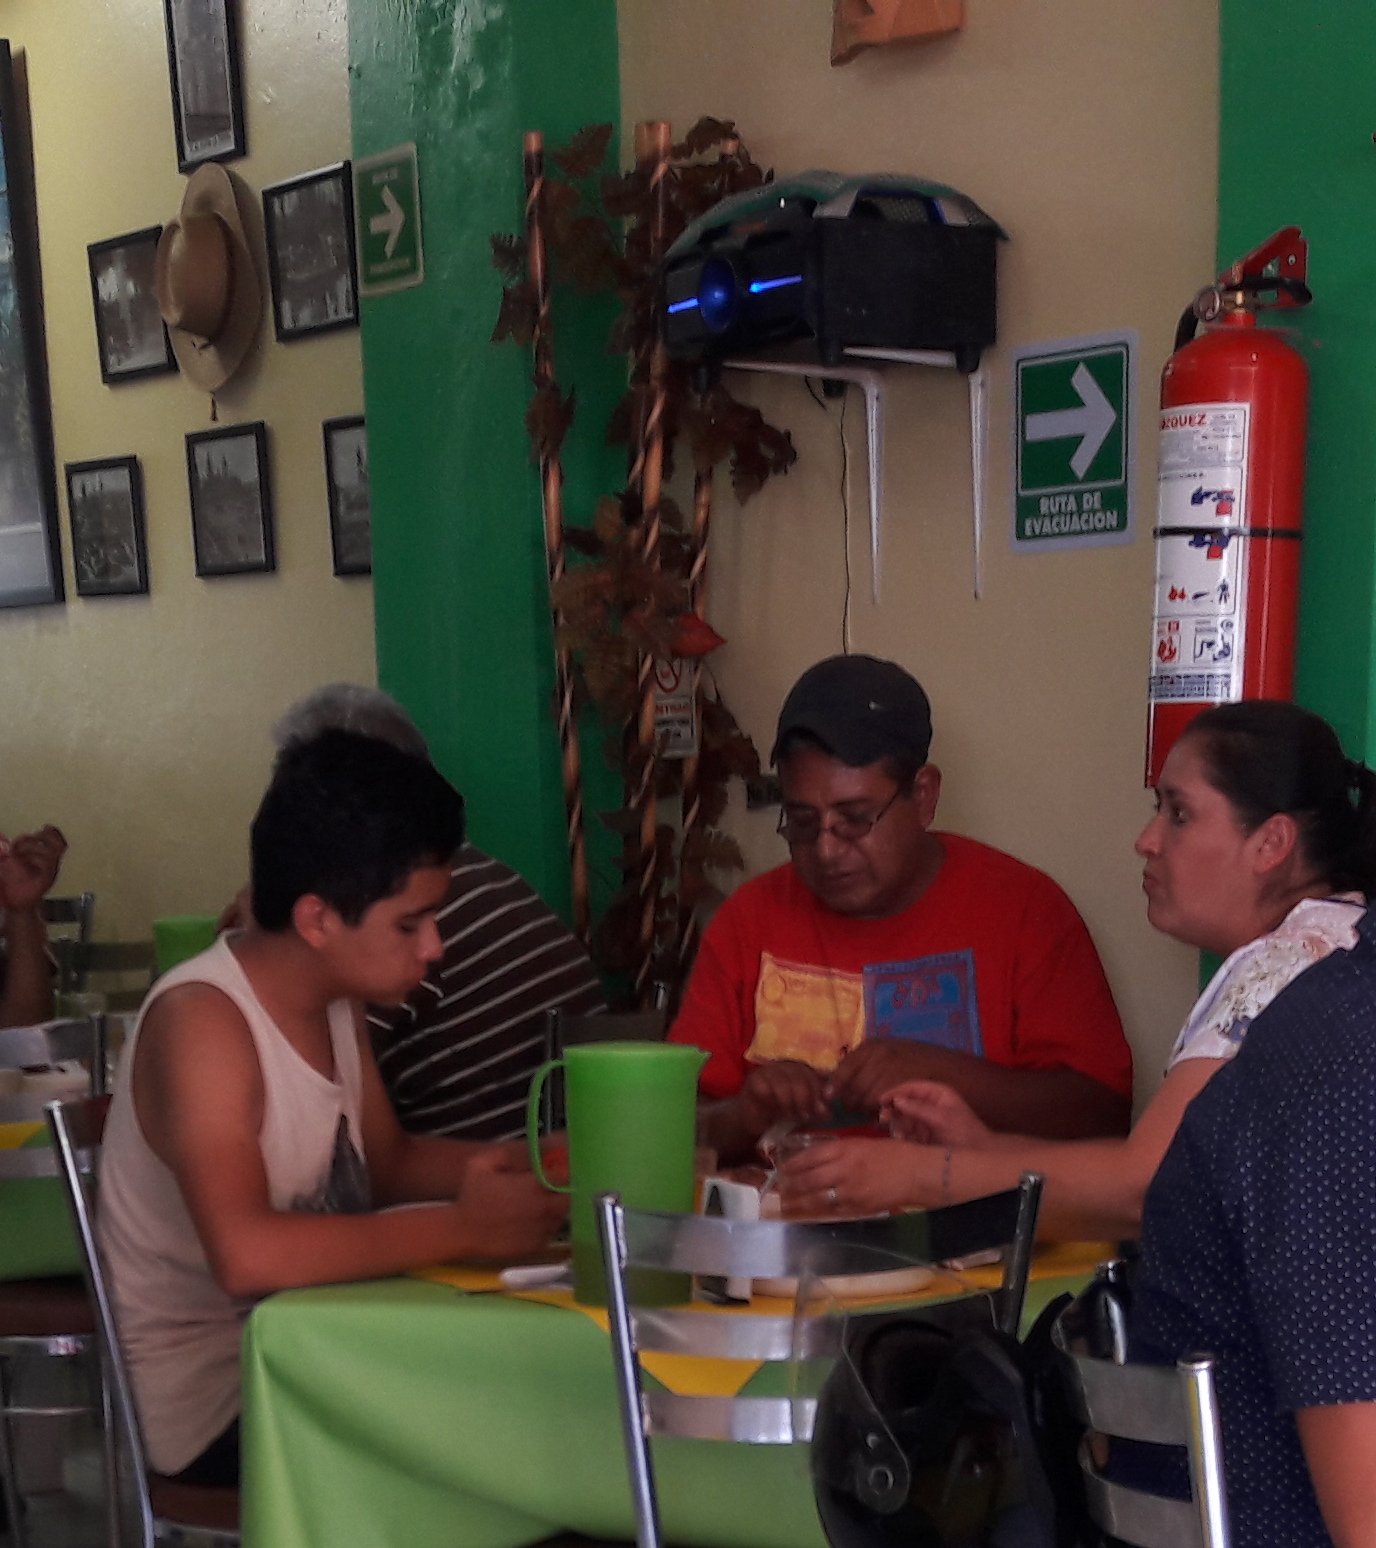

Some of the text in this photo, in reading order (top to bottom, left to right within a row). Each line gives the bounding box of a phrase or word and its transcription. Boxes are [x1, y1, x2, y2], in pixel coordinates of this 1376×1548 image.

[1040, 491, 1102, 516] RUTA DE
[1024, 510, 1118, 537] EVACUACION
